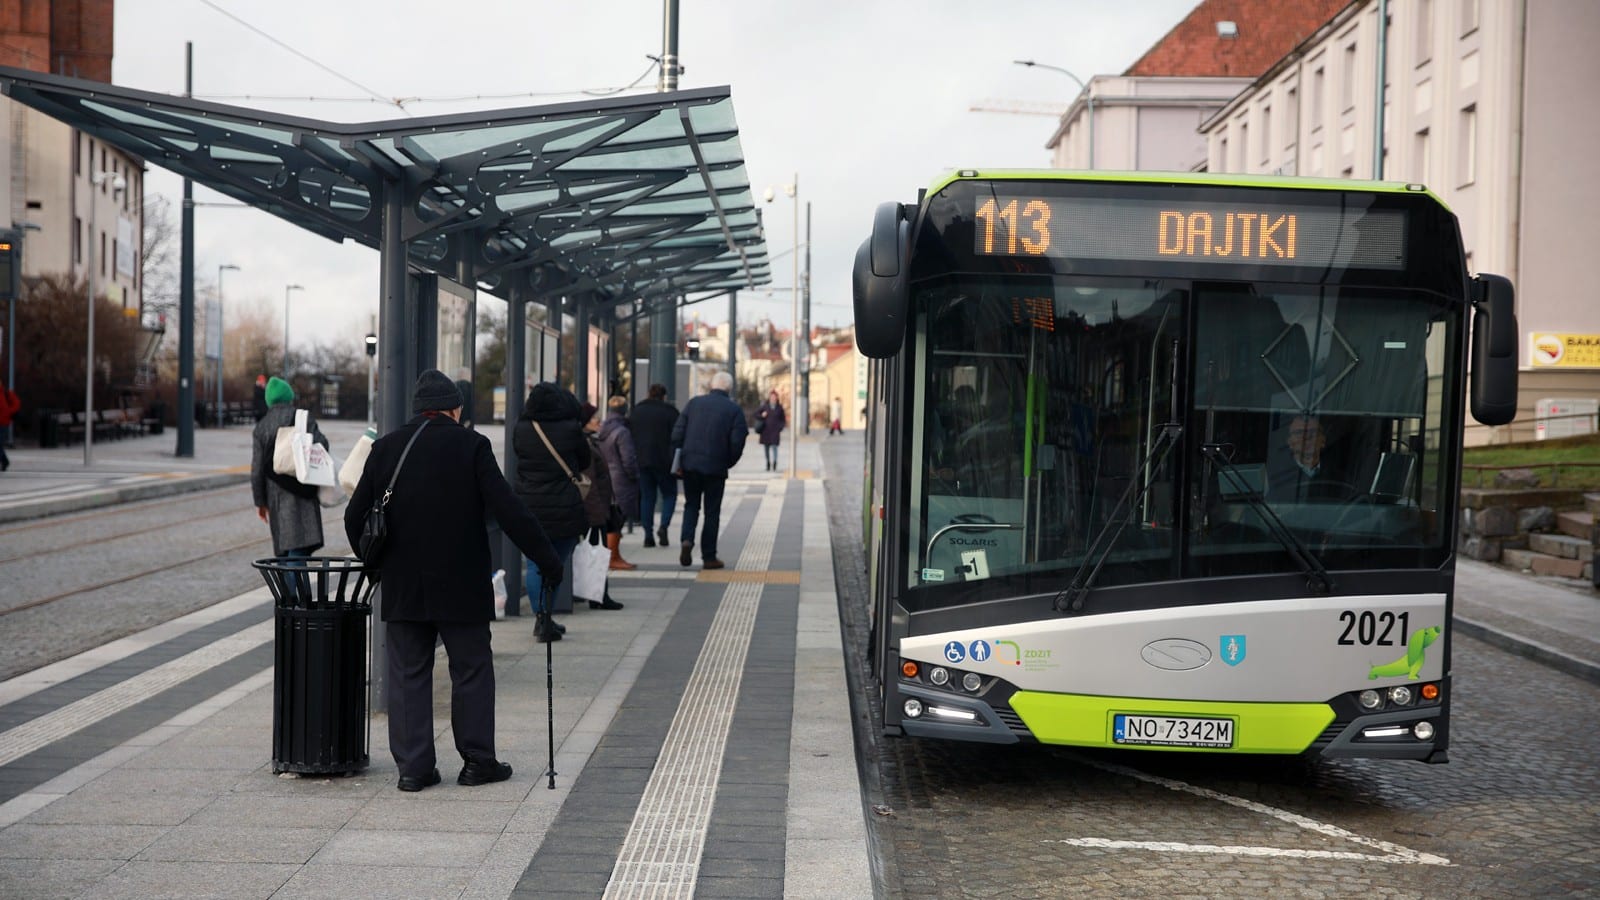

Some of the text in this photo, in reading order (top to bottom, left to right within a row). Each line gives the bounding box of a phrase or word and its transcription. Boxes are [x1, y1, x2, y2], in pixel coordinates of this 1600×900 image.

[975, 198, 1295, 259] 113 DAJTKI
[949, 537, 998, 547] SOLARIS
[970, 558, 979, 576] 1
[1337, 610, 1410, 647] 2021
[1128, 718, 1229, 741] NO 7342M
